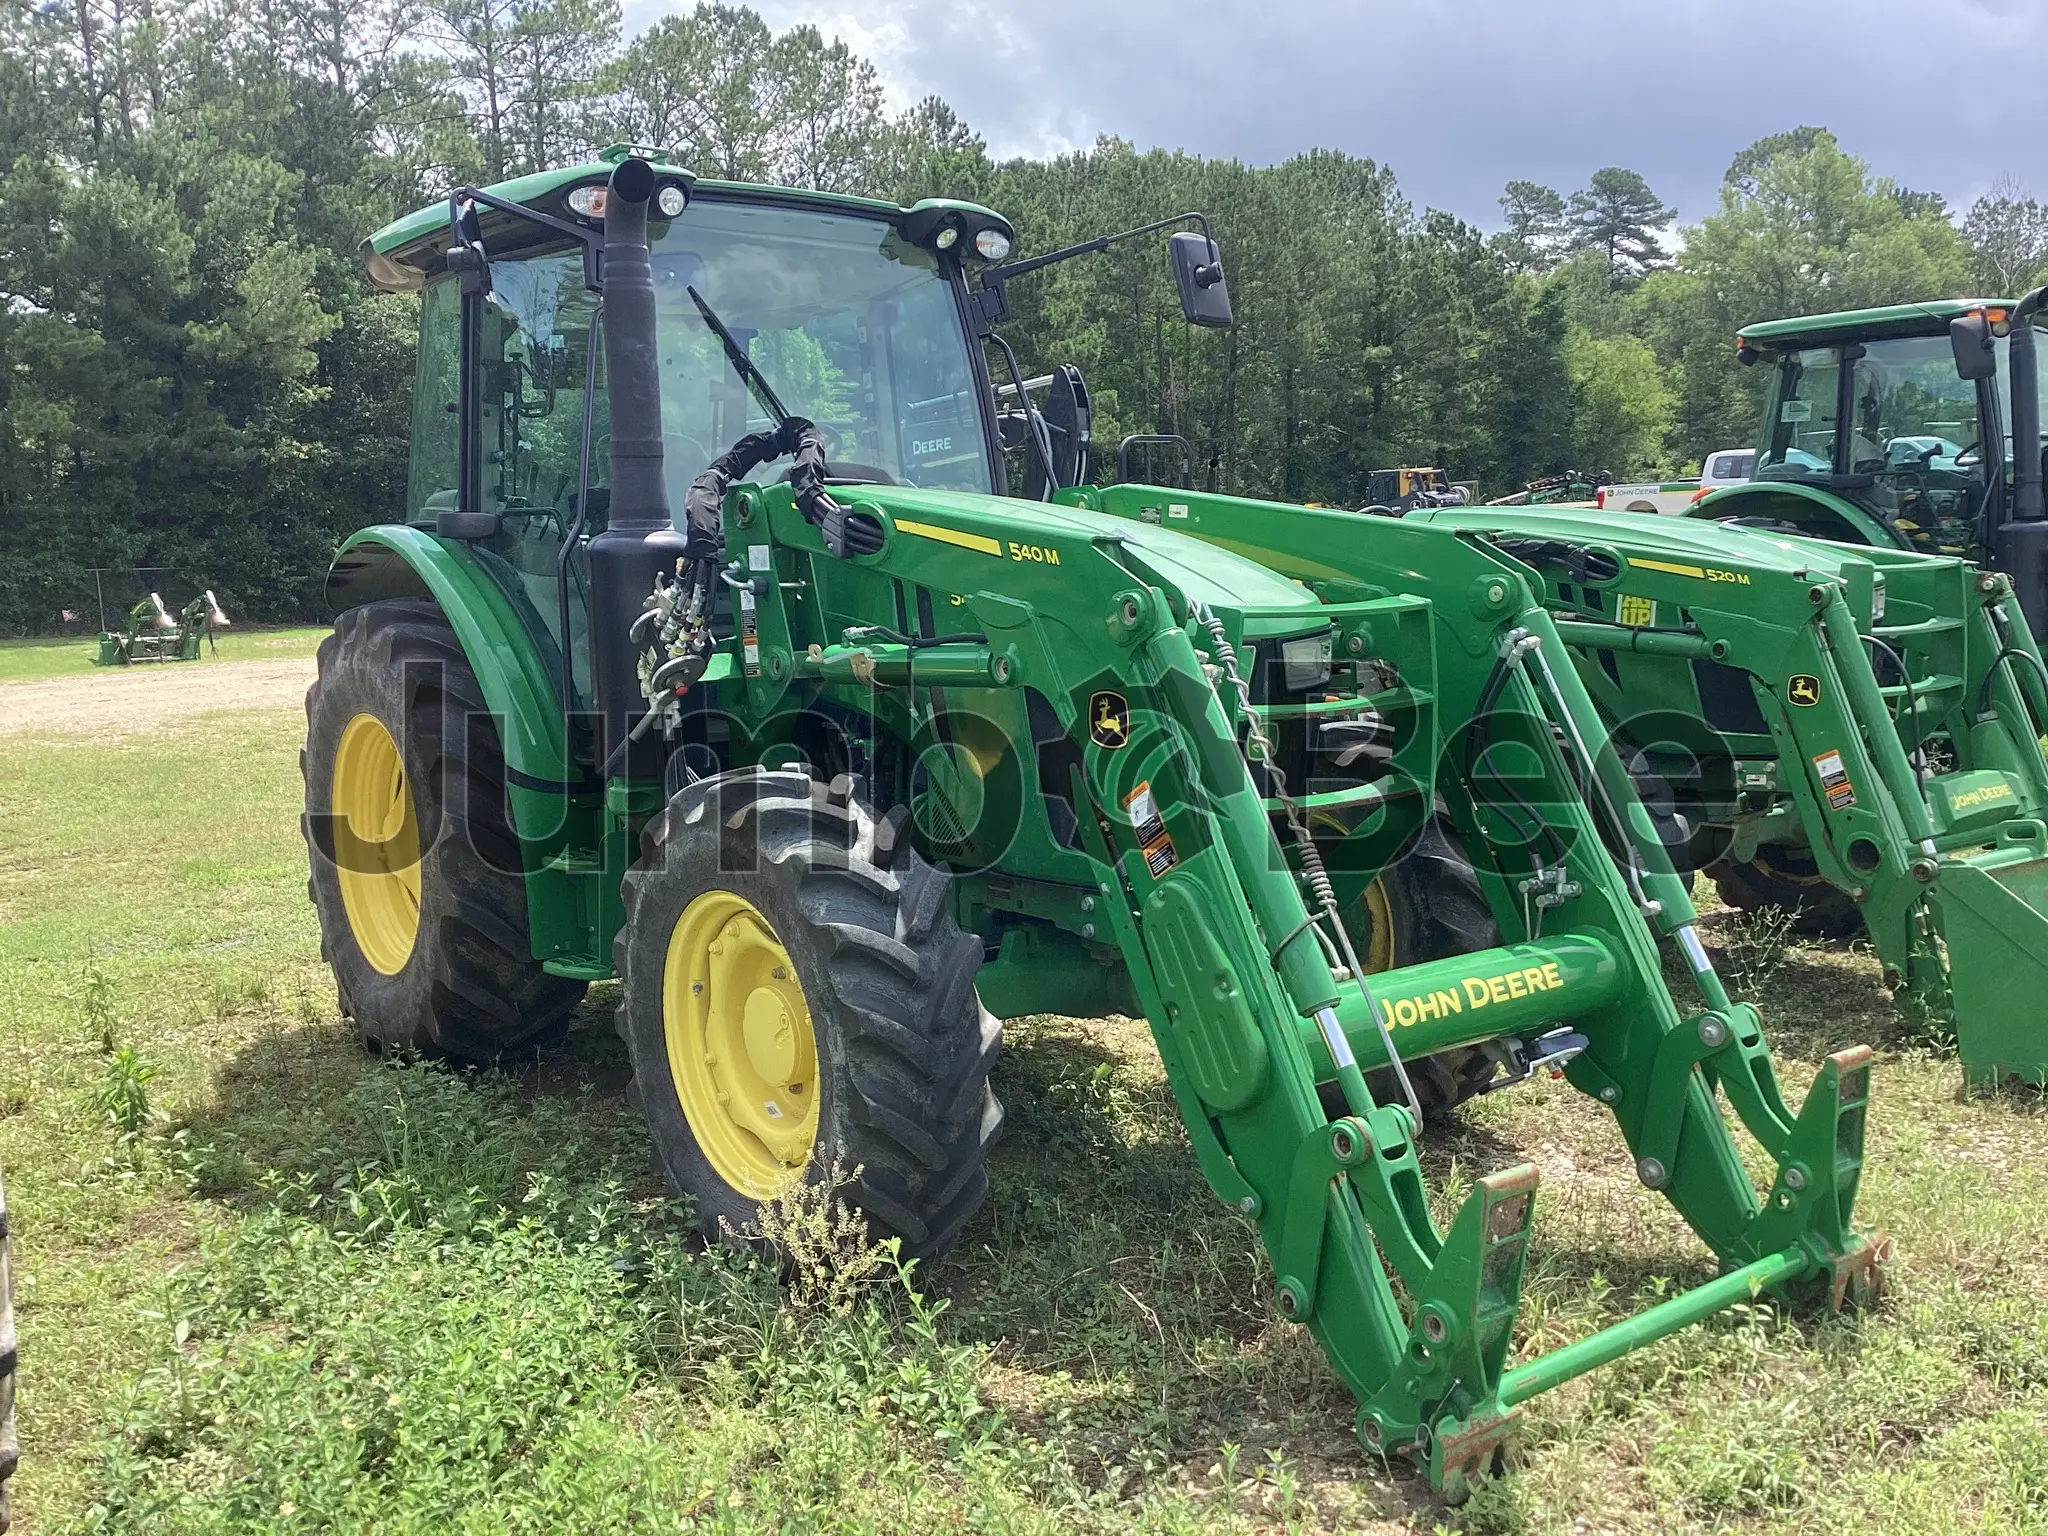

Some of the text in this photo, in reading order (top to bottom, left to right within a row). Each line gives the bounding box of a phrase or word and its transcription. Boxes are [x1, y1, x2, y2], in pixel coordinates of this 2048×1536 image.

[912, 437, 952, 455] DEERE
[1008, 541, 1060, 566] 540 M
[1705, 568, 1751, 585] 520 M
[1621, 608, 1651, 626] UP
[1953, 784, 2011, 810] JOHN DEERE
[1381, 962, 1564, 1032] JOHN DEERE
